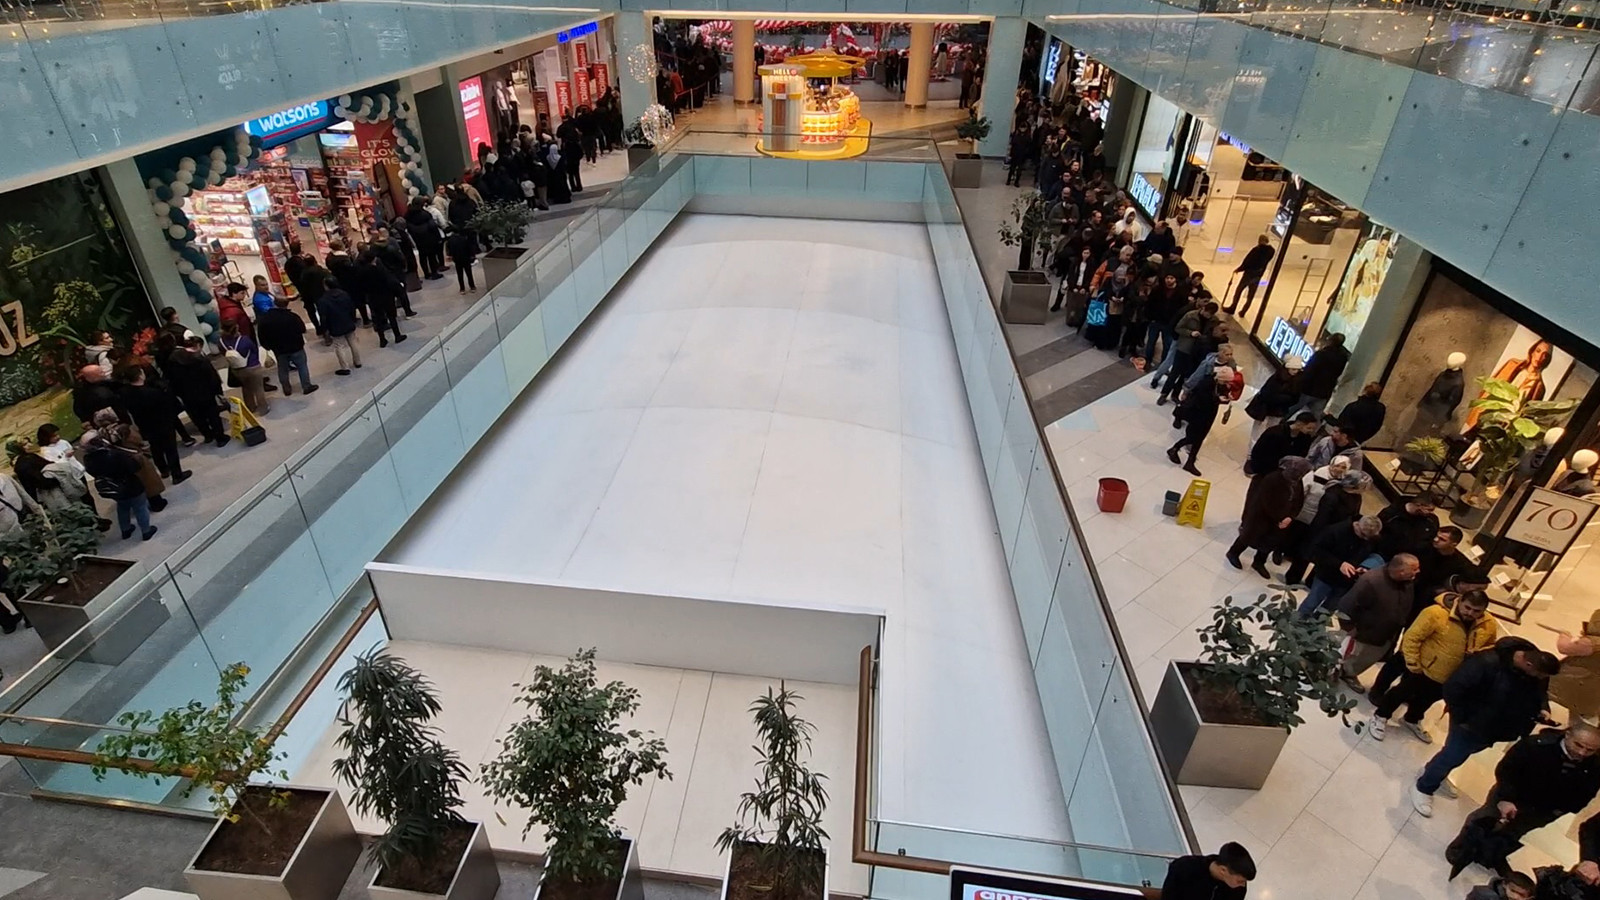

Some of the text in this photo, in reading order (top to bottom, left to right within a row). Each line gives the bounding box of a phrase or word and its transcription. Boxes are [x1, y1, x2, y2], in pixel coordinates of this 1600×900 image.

[258, 101, 320, 132] watsons
[366, 139, 391, 148] IT'S
[1526, 499, 1578, 531] 70
